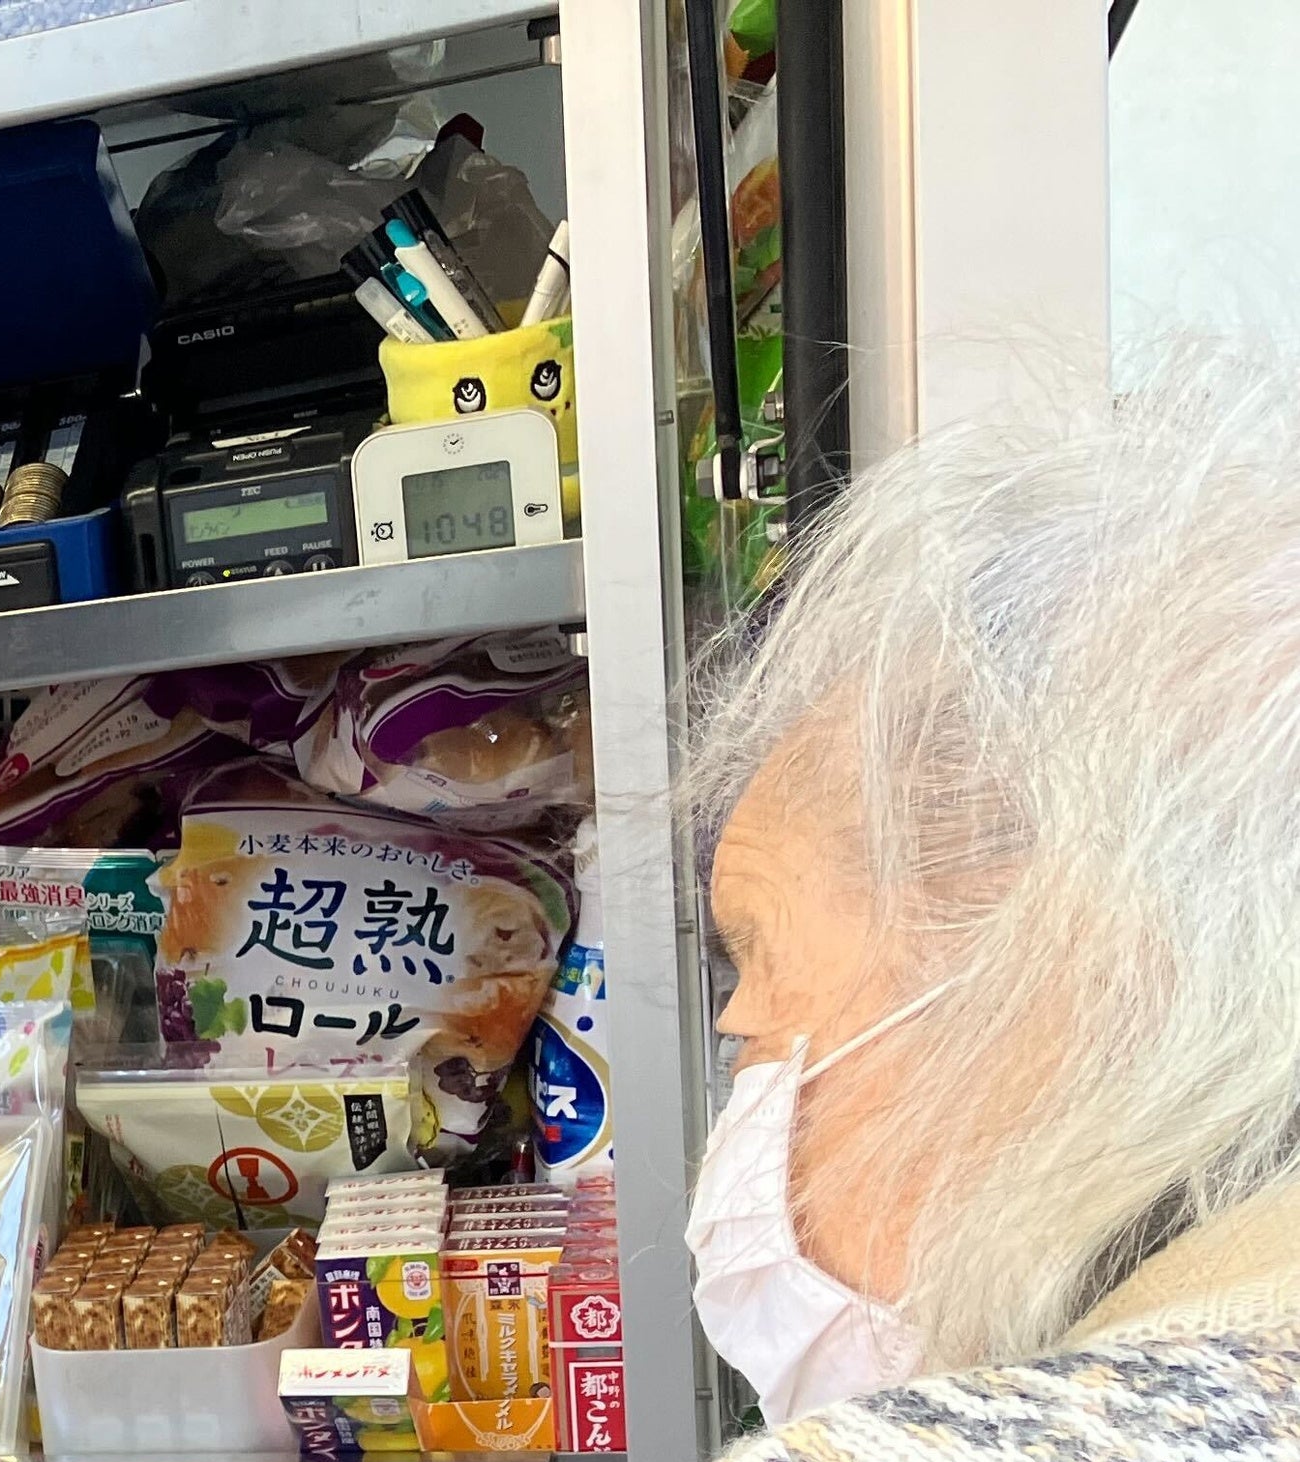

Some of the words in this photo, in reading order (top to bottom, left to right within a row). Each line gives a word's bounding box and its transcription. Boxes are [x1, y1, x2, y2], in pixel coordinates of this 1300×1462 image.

[176, 325, 235, 346] CASIO
[241, 485, 262, 497] TEC
[264, 546, 289, 557] FEED
[302, 539, 333, 551] PAUSE
[181, 557, 215, 570] POWER
[239, 833, 481, 887] 小麦本来のおいしさ。
[0, 880, 85, 909] 最強消臭
[235, 866, 456, 986] 超熟
[274, 974, 400, 1000] CHOUJUKU
[249, 993, 421, 1046] ロール
[329, 1284, 364, 1349] ボン
[583, 1308, 607, 1332] 都
[607, 1370, 621, 1409] 中野の
[581, 1371, 612, 1451] 都こん
